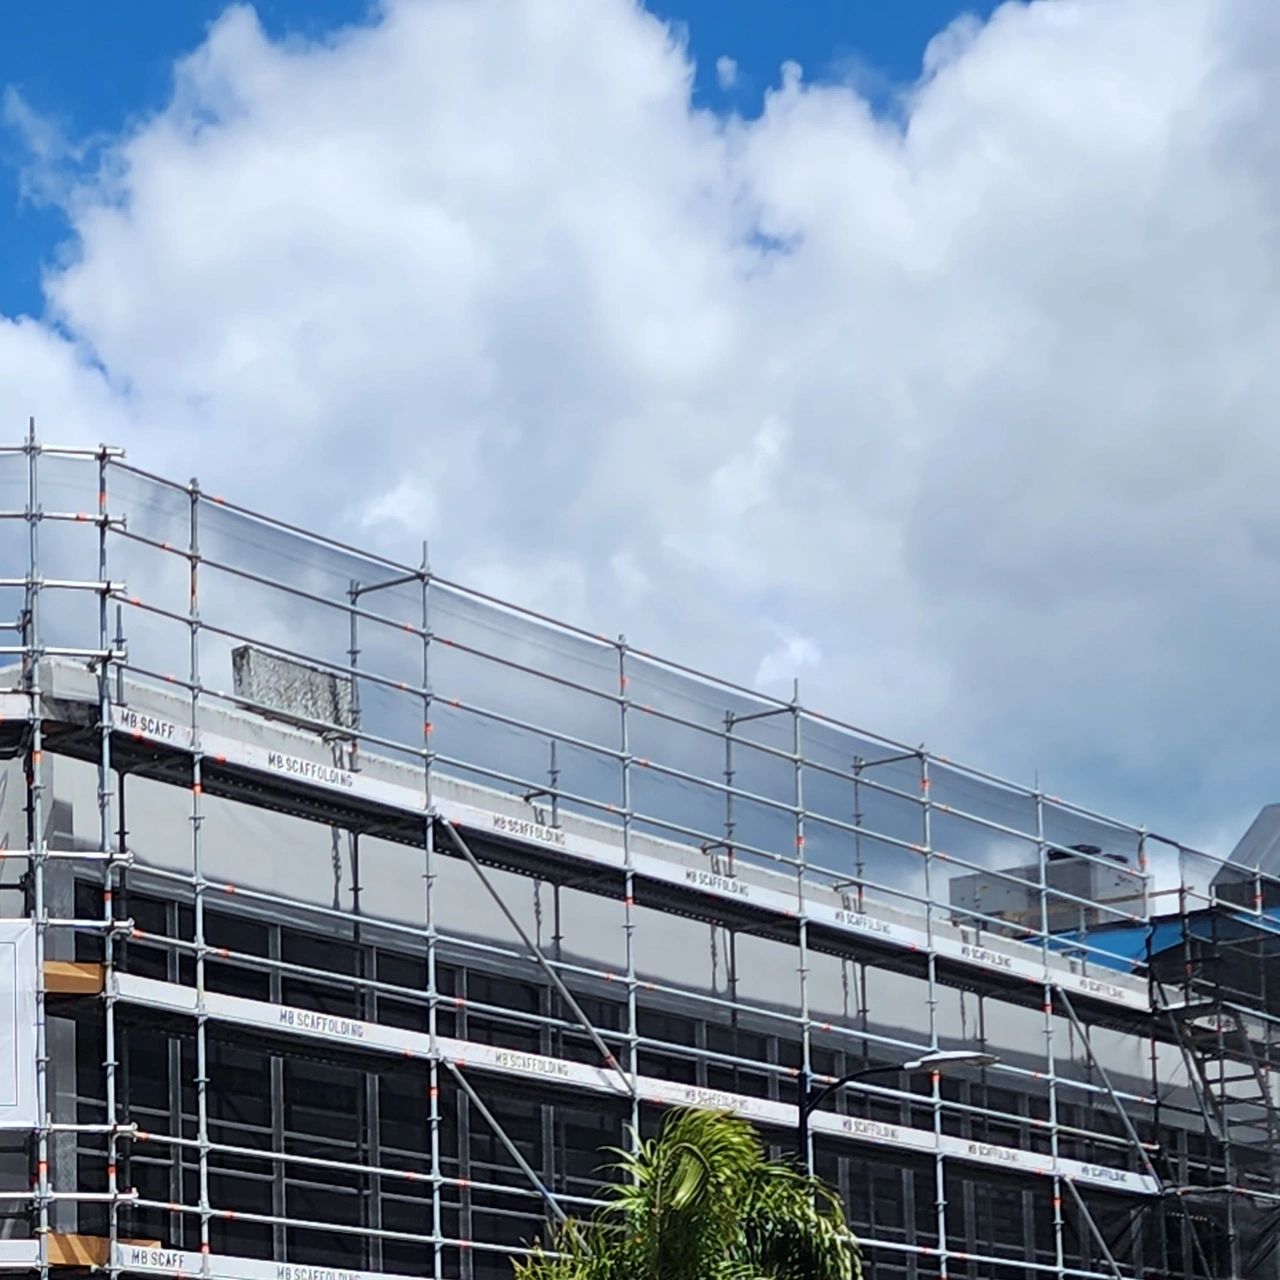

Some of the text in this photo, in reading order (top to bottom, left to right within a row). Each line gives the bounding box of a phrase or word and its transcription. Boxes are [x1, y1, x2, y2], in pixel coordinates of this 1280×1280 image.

[120, 709, 175, 739] MB SCAFF
[268, 752, 353, 787] MB SCAFFOLDING
[508, 818, 565, 845] SCAFFOLDING
[280, 1008, 364, 1039] MB SCAFFOLDING
[509, 1055, 569, 1077] SCAFFOLDING
[131, 1249, 185, 1269] MB SCAFF
